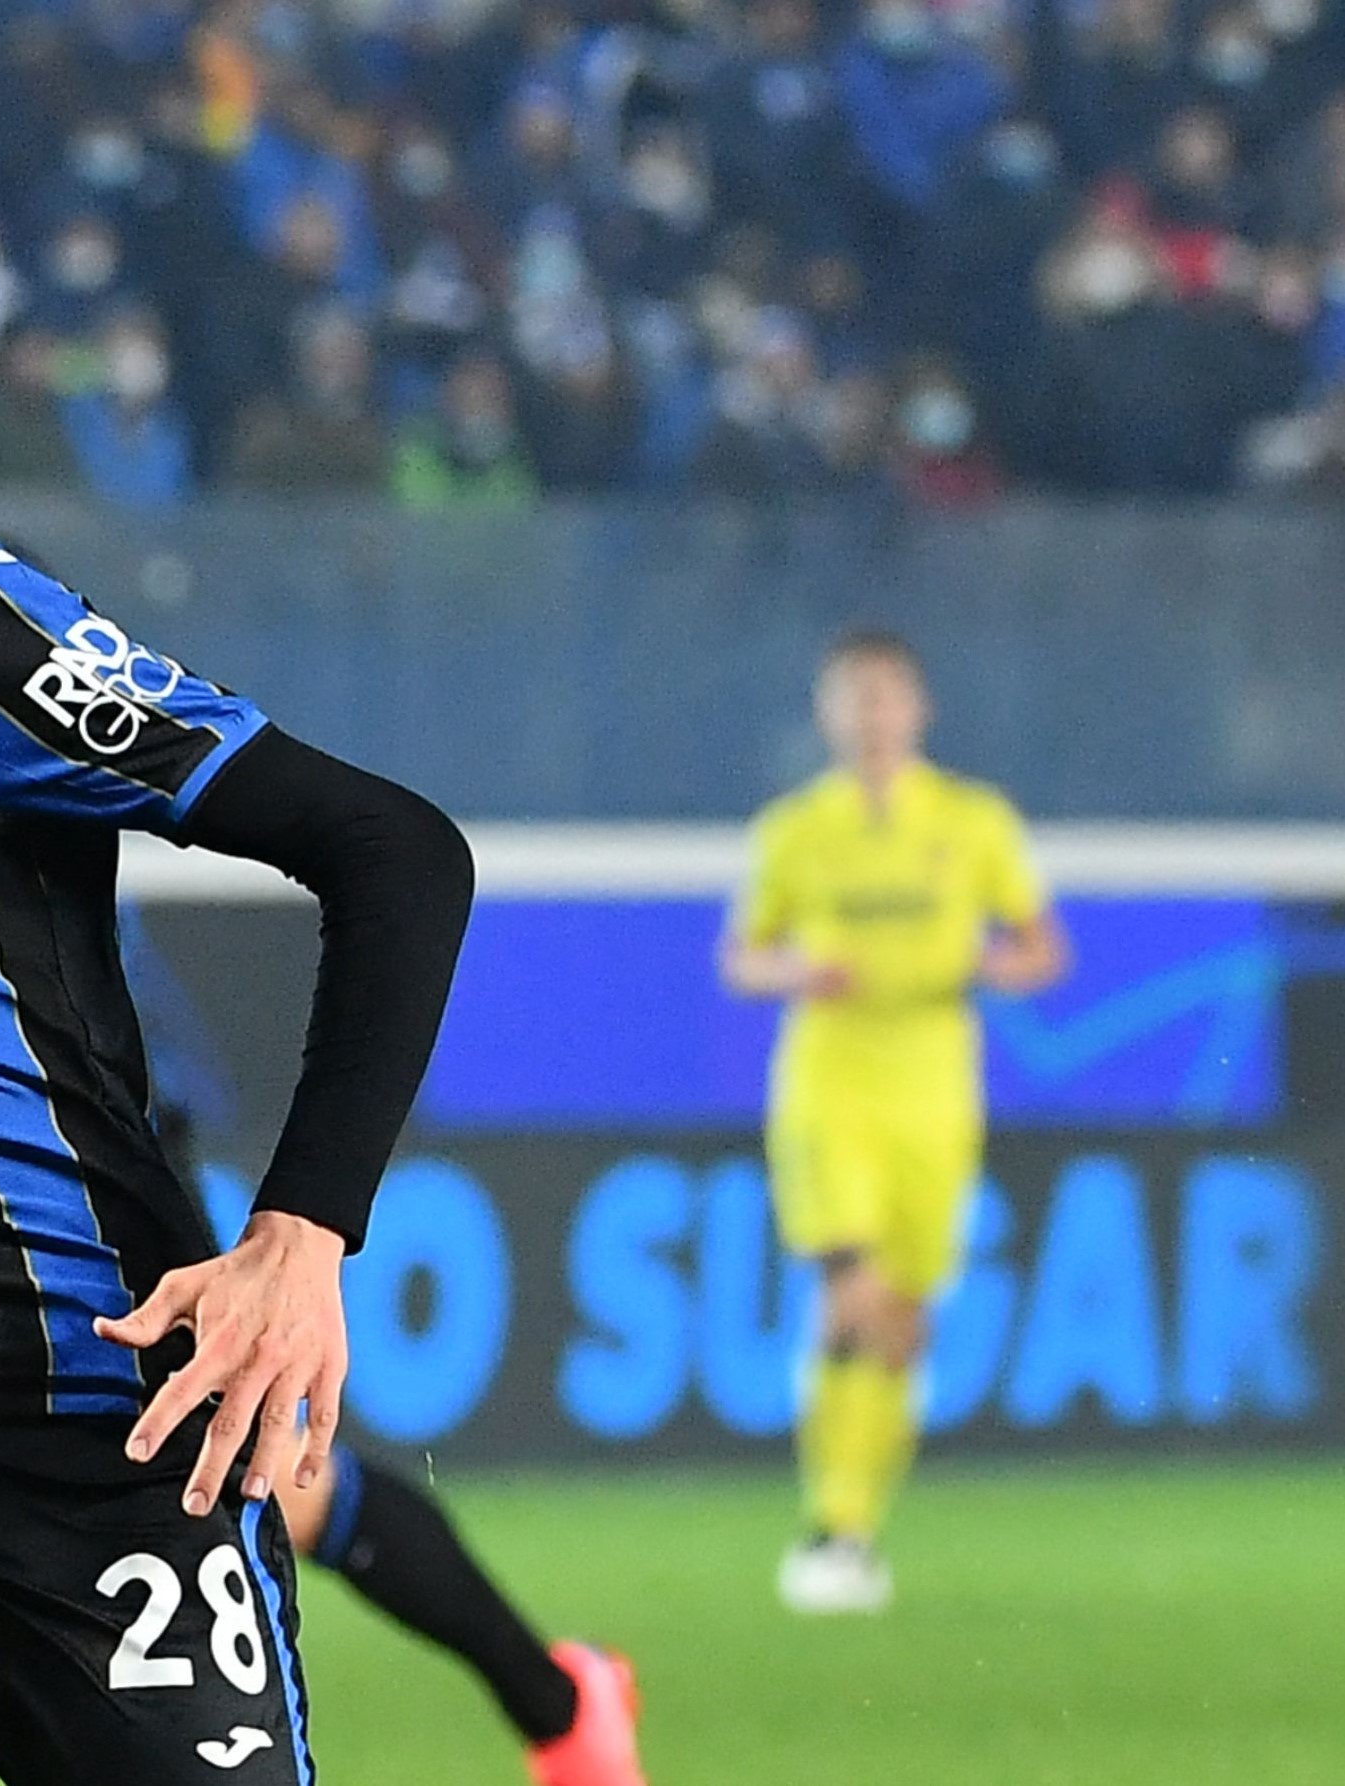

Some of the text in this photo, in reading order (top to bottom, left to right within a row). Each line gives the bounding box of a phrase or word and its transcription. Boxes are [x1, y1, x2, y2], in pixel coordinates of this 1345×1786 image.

[23, 610, 129, 728] RAD
[79, 643, 185, 754] GRO
[95, 1544, 267, 1695] 28
